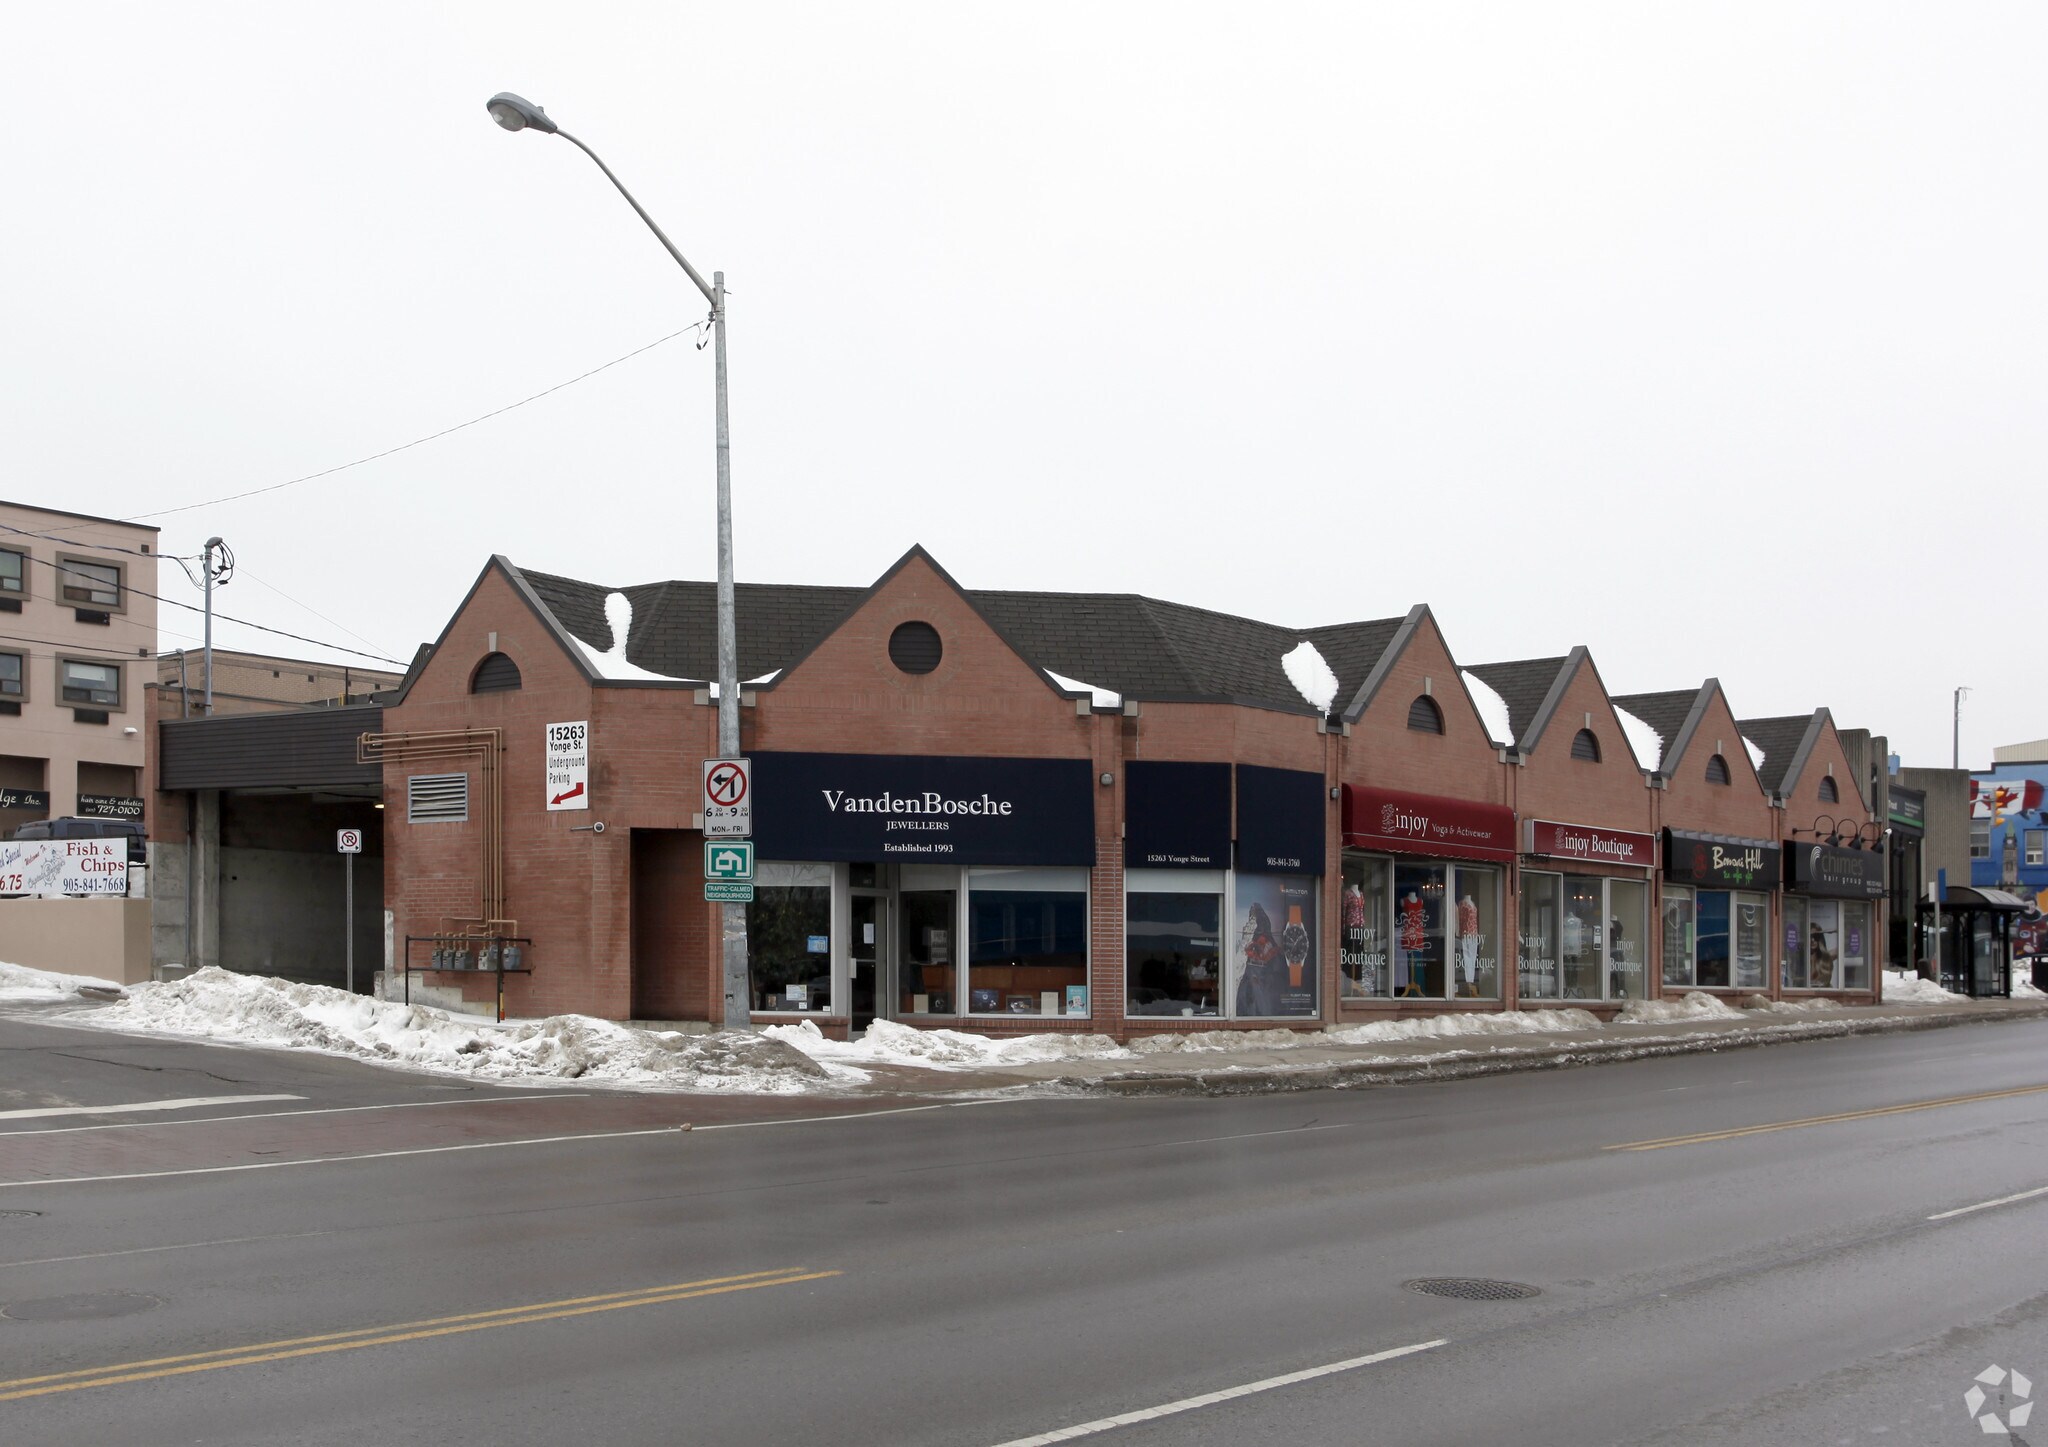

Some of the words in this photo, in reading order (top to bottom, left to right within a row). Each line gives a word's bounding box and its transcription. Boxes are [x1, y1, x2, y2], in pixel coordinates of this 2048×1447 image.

[550, 725, 585, 741] 15263
[550, 742, 571, 753] Yonge
[573, 740, 584, 750] St.
[549, 755, 585, 769] Underground
[549, 772, 571, 786] Parking
[109, 797, 116, 805] &
[821, 790, 1012, 815] VandenBosche
[97, 805, 141, 815] 727-0100
[705, 807, 713, 817] 6
[730, 807, 738, 817] 9
[711, 825, 726, 833] MON
[886, 821, 949, 831] JEWELLERS
[1396, 807, 1428, 837] injoy
[1432, 823, 1448, 837] Yoga
[1449, 825, 1455, 834] &
[1456, 826, 1492, 839] Activewear
[66, 841, 99, 856] Fish
[103, 845, 113, 855] &
[884, 843, 932, 852] Established
[934, 844, 954, 852] 1993
[1565, 831, 1590, 856] injoy
[1592, 834, 1634, 860] Boutique
[80, 858, 125, 875] Chips
[1147, 854, 1167, 862] 15263
[1168, 855, 1189, 864] Yonge
[1190, 855, 1210, 863] Street
[1266, 857, 1301, 867] 905-841-3760
[1745, 848, 1764, 872] Hill
[1821, 849, 1864, 875] chimes
[63, 878, 125, 892] 905-841-7668
[1823, 873, 1839, 882] hair
[1842, 876, 1861, 885] group
[1350, 927, 1376, 945] injoy
[1525, 933, 1547, 952] injoy
[1616, 937, 1635, 955] injoy
[1340, 948, 1386, 970] Boutique
[1518, 955, 1555, 974] Boutique
[1609, 958, 1642, 976] Boutique
